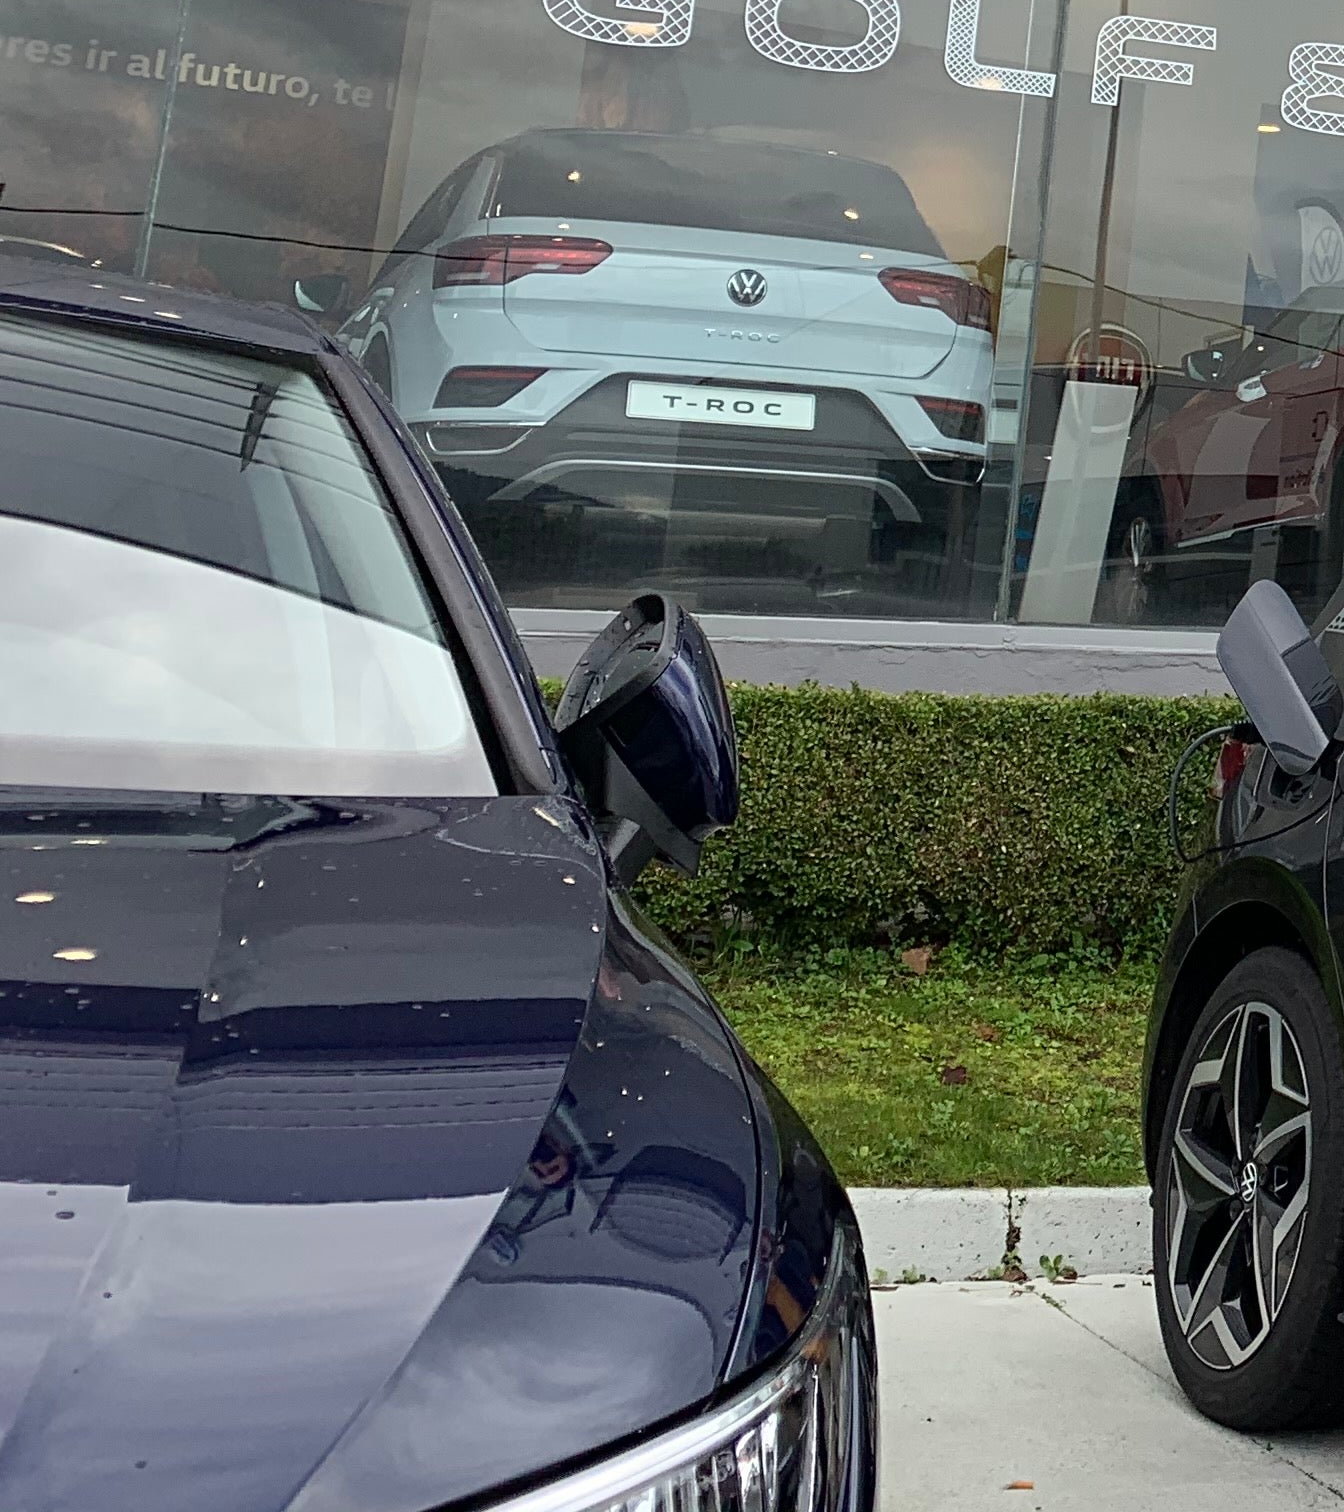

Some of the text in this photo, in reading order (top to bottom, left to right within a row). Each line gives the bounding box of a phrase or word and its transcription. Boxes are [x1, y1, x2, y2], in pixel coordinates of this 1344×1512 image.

[0, 34, 73, 67] res
[85, 38, 117, 72] ir
[127, 49, 166, 80] al
[178, 52, 319, 107] futuro,
[332, 77, 374, 108] te
[703, 328, 781, 344] T-ROC
[663, 394, 782, 417] T-ROC
